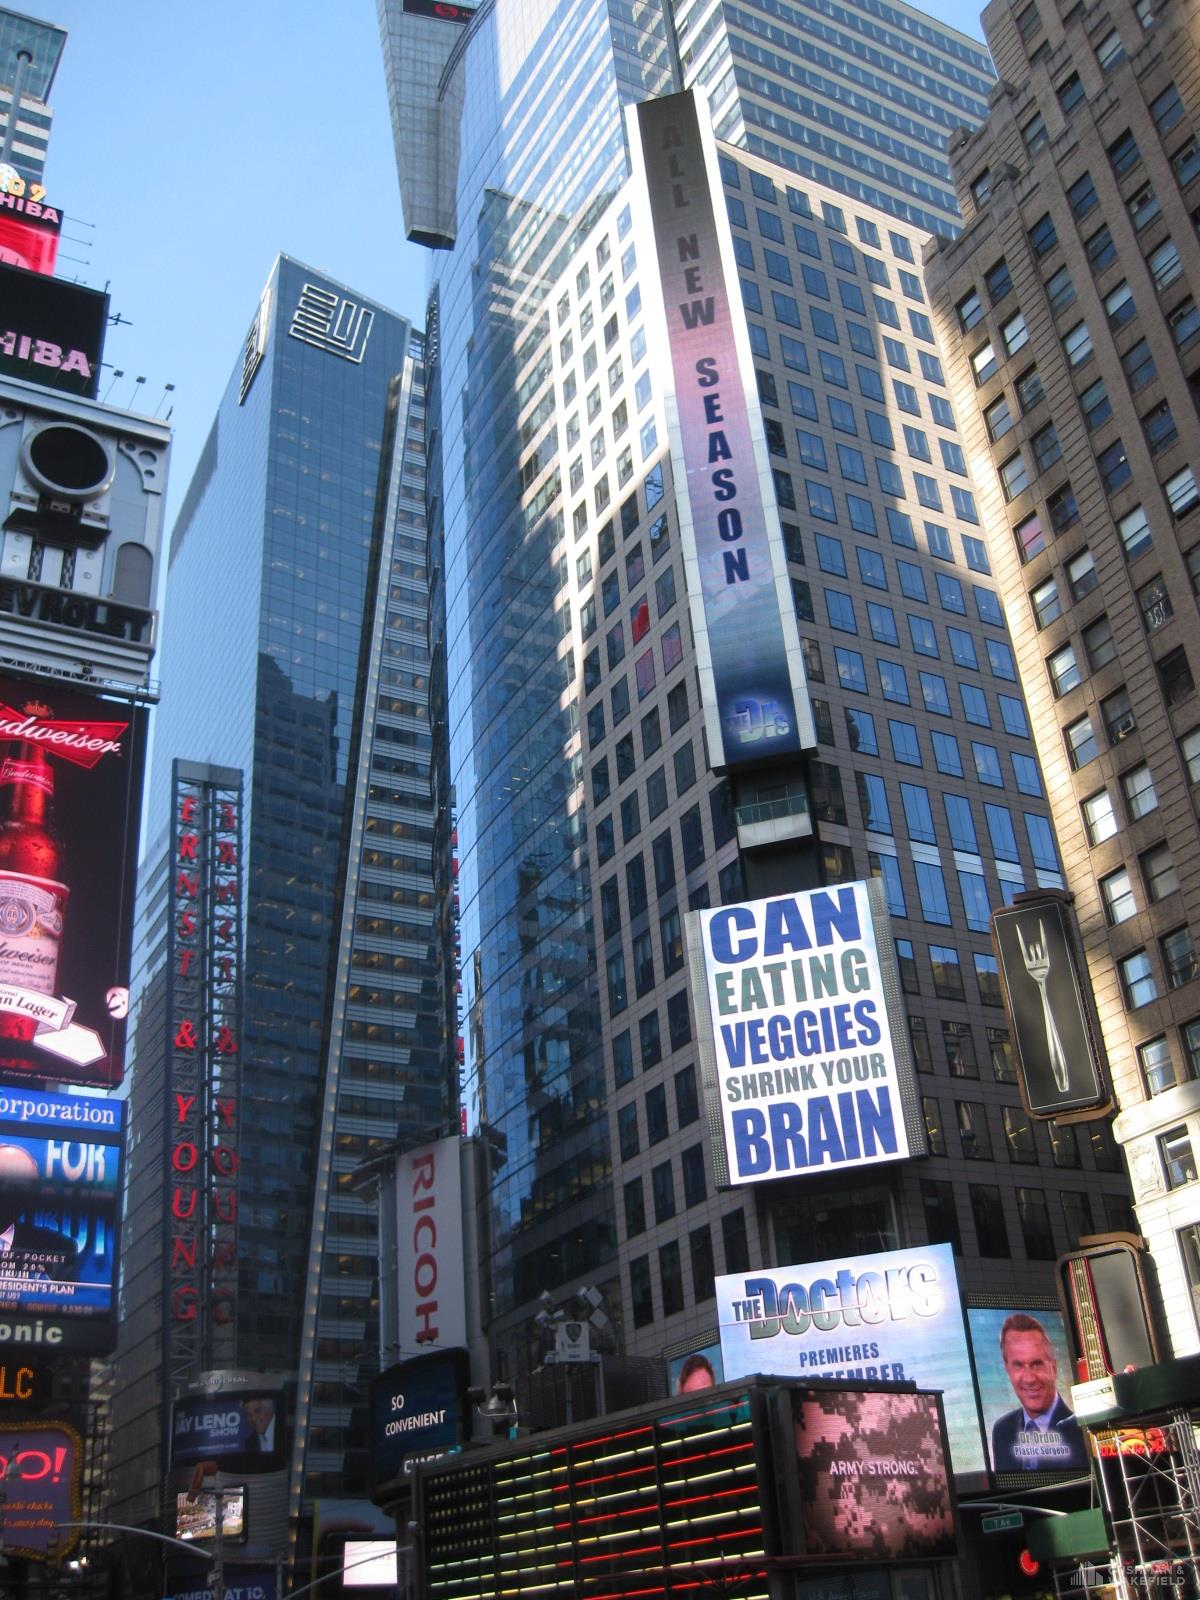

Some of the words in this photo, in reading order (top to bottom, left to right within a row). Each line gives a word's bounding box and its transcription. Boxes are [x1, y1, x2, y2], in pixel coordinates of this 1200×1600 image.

[662, 126, 690, 209] ALL
[677, 233, 716, 330] NEW
[695, 357, 751, 585] SEASON
[176, 797, 198, 976] ERNST
[709, 886, 862, 965] CAN
[714, 948, 871, 1016] EATING
[17, 997, 58, 1019] Lager
[175, 1020, 197, 1048] &
[720, 999, 881, 1069] VEGGIES
[725, 1063, 818, 1103] SHRINK
[820, 1052, 888, 1091] YOUR
[730, 1085, 899, 1178] BRAIN
[171, 1094, 198, 1321] YOUNG
[411, 1151, 440, 1345] RICOH
[49, 1285, 75, 1295] PLAN
[744, 1263, 942, 1341] Doctors
[732, 1298, 762, 1322] THE
[799, 1342, 880, 1368] PREMIERES
[391, 1394, 405, 1411] SO
[195, 1411, 241, 1431] LENO
[209, 1427, 239, 1438] SHOW
[385, 1409, 447, 1436] CONVENIENT
[1014, 1445, 1039, 1457] Plastic
[1040, 1445, 1070, 1457] Surgeon
[1033, 1431, 1060, 1444] Ordon
[829, 1461, 865, 1475] ARMY
[224, 1588, 244, 1600] AT
